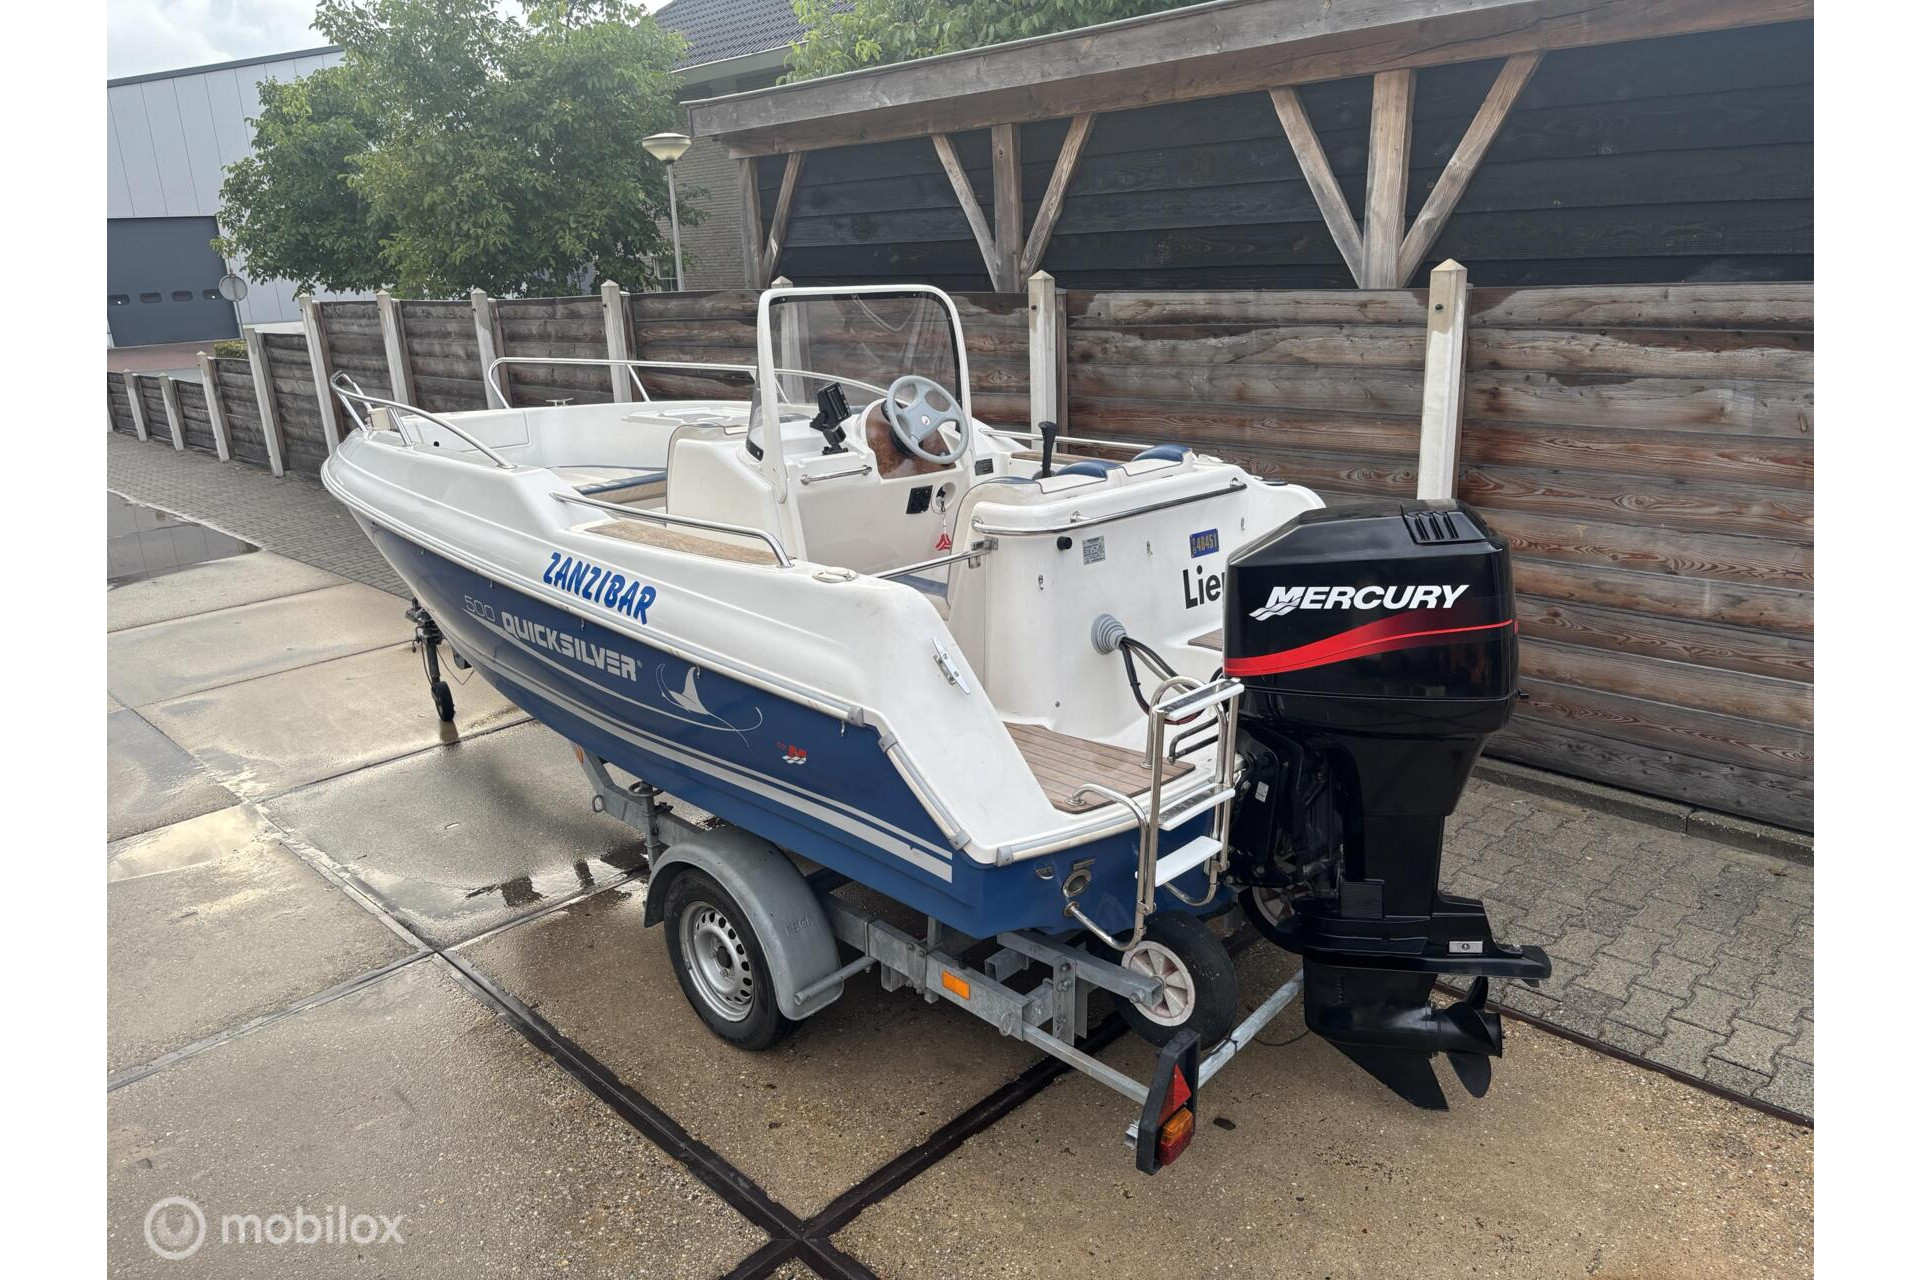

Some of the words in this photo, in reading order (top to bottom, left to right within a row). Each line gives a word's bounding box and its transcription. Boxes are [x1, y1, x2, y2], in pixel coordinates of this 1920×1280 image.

[543, 551, 657, 625] ZANZIBAR
[1248, 584, 1469, 621] MERCURY
[464, 594, 496, 622] 500
[501, 611, 638, 682] QUICKSILVER
